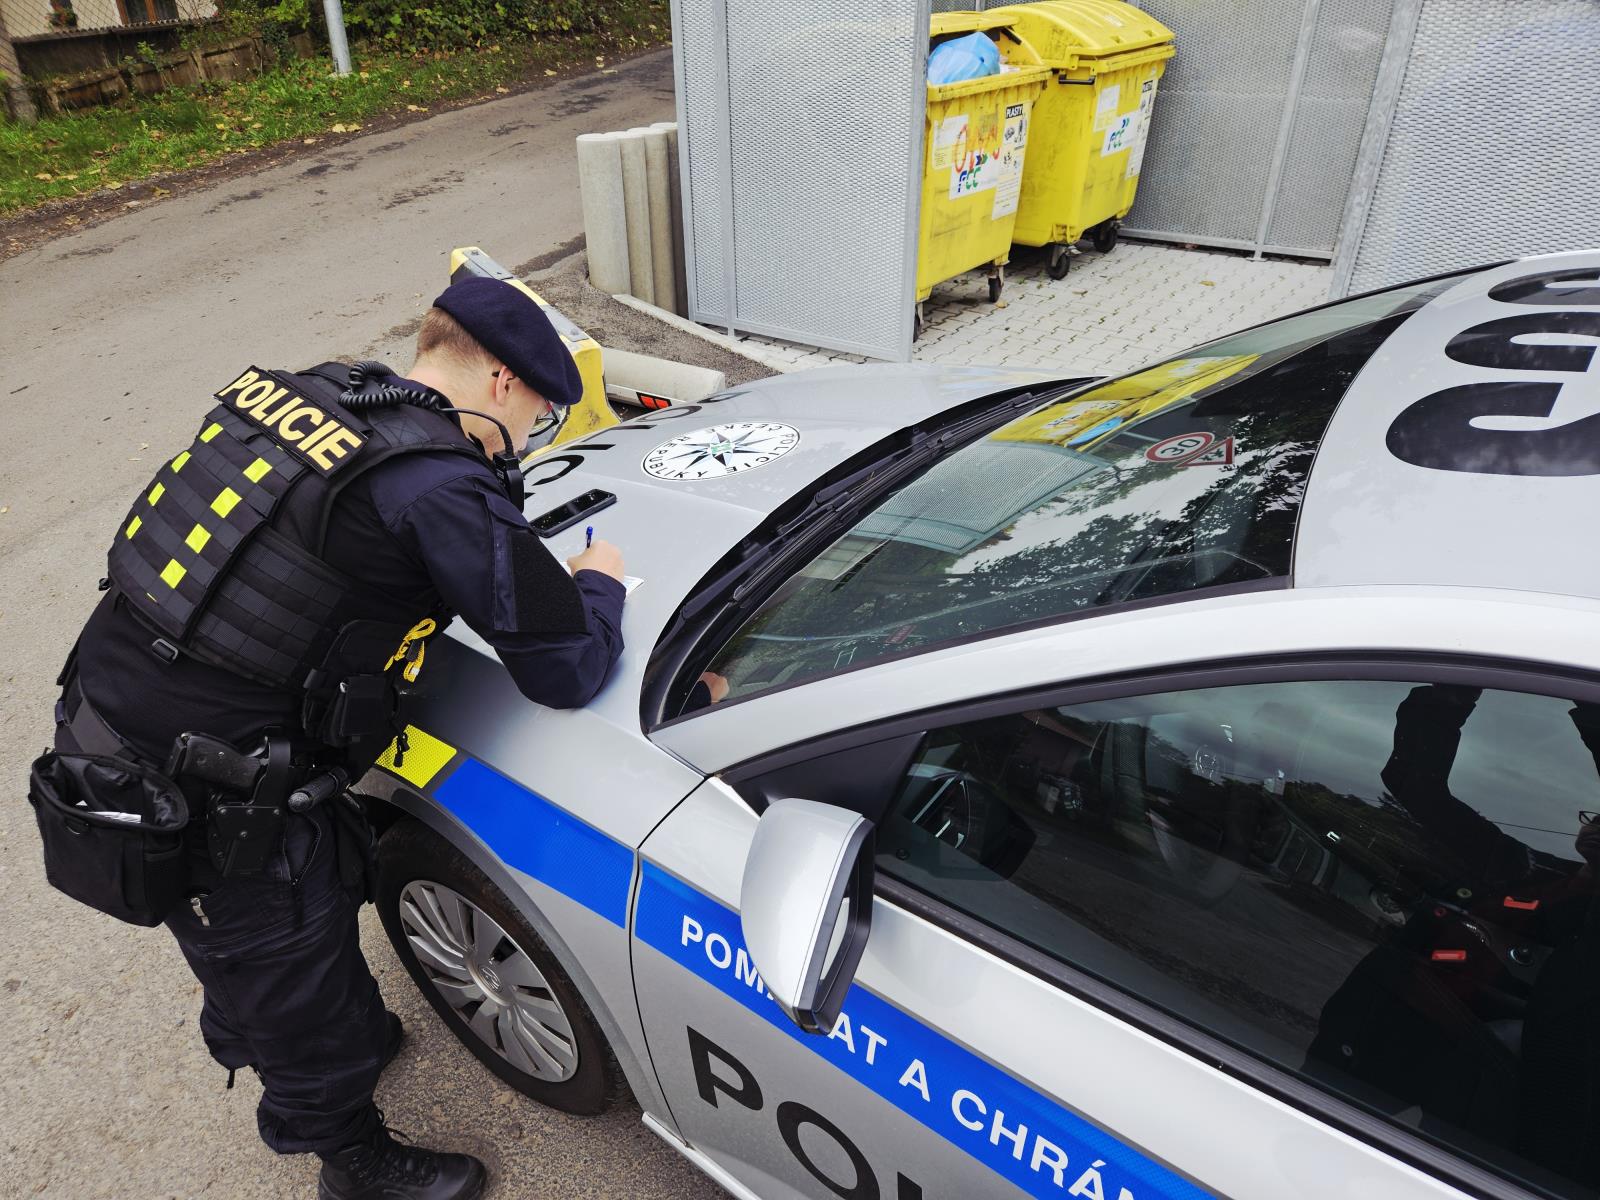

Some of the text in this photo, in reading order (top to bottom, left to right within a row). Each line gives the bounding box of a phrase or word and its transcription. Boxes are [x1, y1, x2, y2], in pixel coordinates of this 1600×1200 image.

[219, 370, 362, 470] POLICIE
[1160, 438, 1201, 456] 30
[649, 436, 708, 478] REPUBLIKY
[681, 914, 1136, 1200] POMAT A CHRÁ
